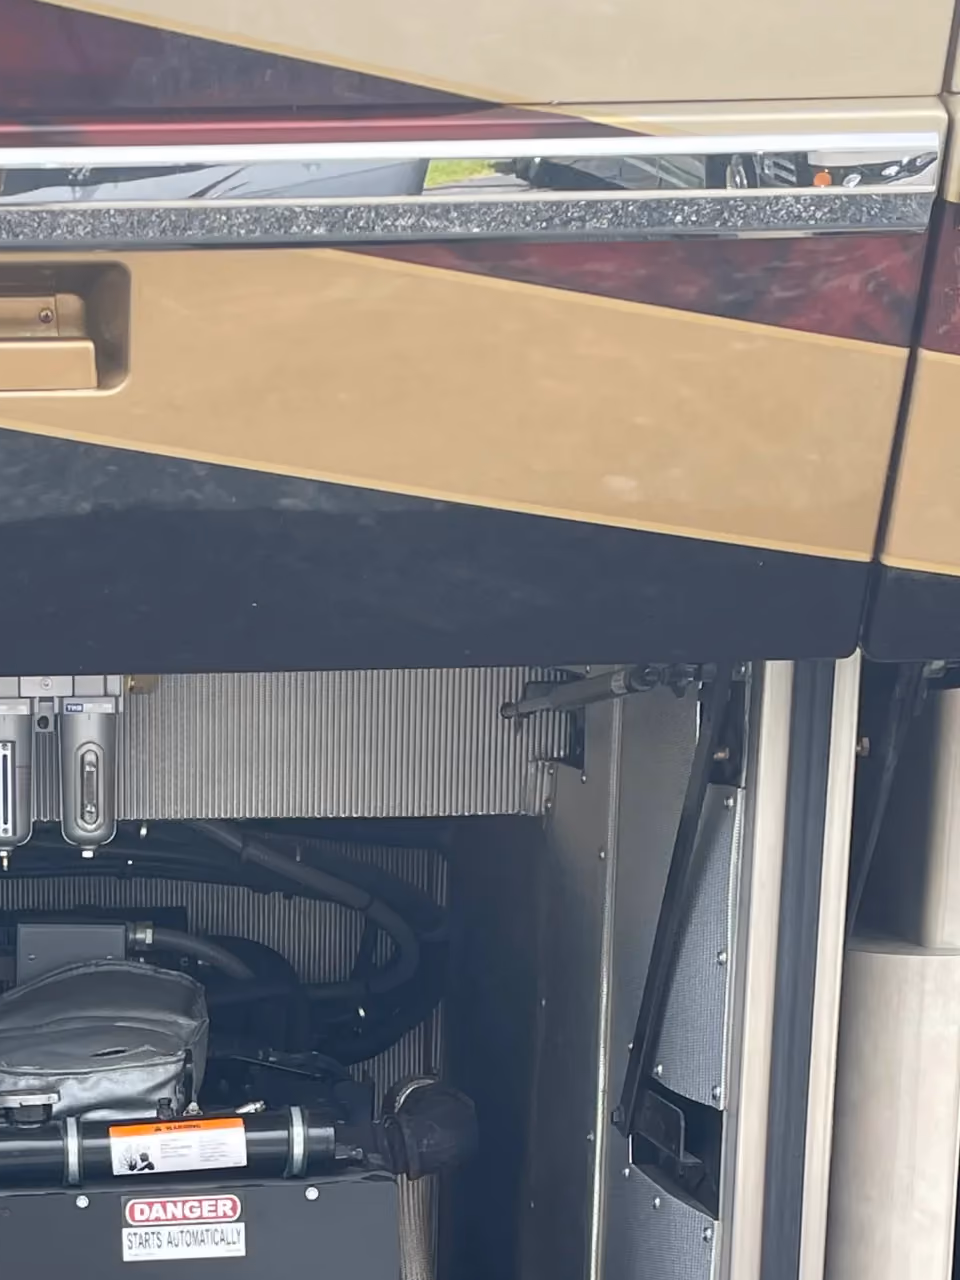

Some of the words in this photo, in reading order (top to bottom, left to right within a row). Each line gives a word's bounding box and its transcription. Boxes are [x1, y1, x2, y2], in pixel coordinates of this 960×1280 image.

[133, 1199, 234, 1221] DANGER
[127, 1231, 163, 1250] STARTS
[167, 1227, 242, 1248] AUTOMATICALLY
